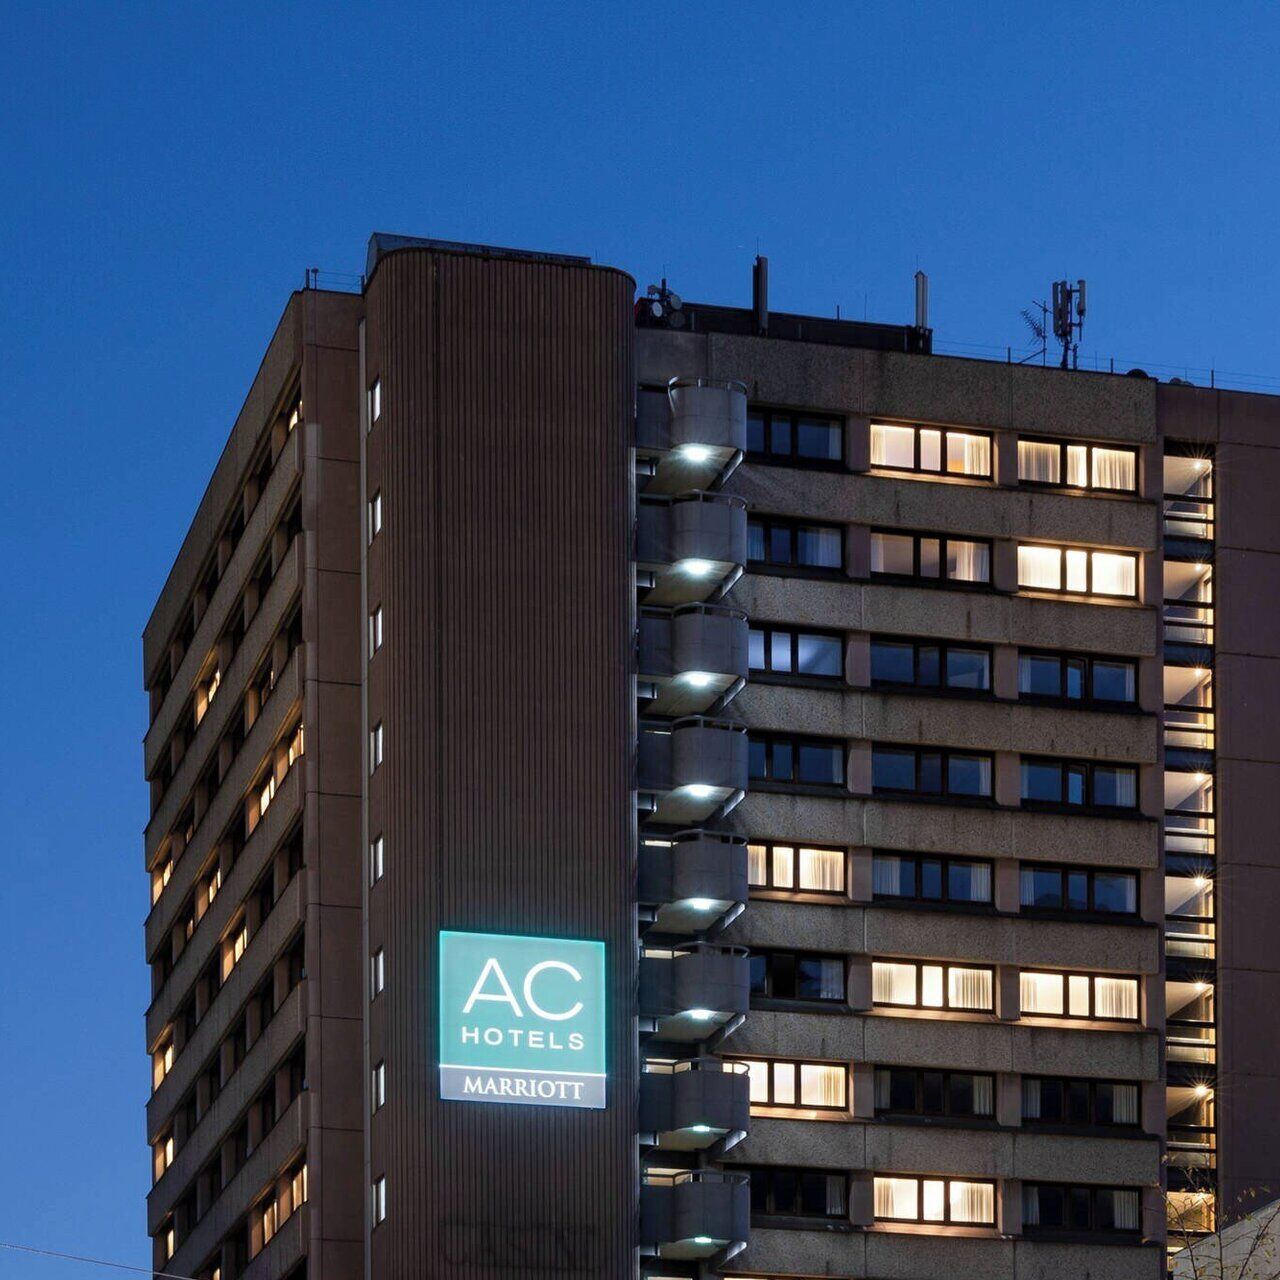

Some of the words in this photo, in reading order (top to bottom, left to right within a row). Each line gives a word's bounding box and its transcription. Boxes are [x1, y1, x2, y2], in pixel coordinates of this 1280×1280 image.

[462, 958, 584, 1021] AC
[461, 1026, 585, 1051] HOTELS
[464, 1076, 584, 1100] MARRIOTT
